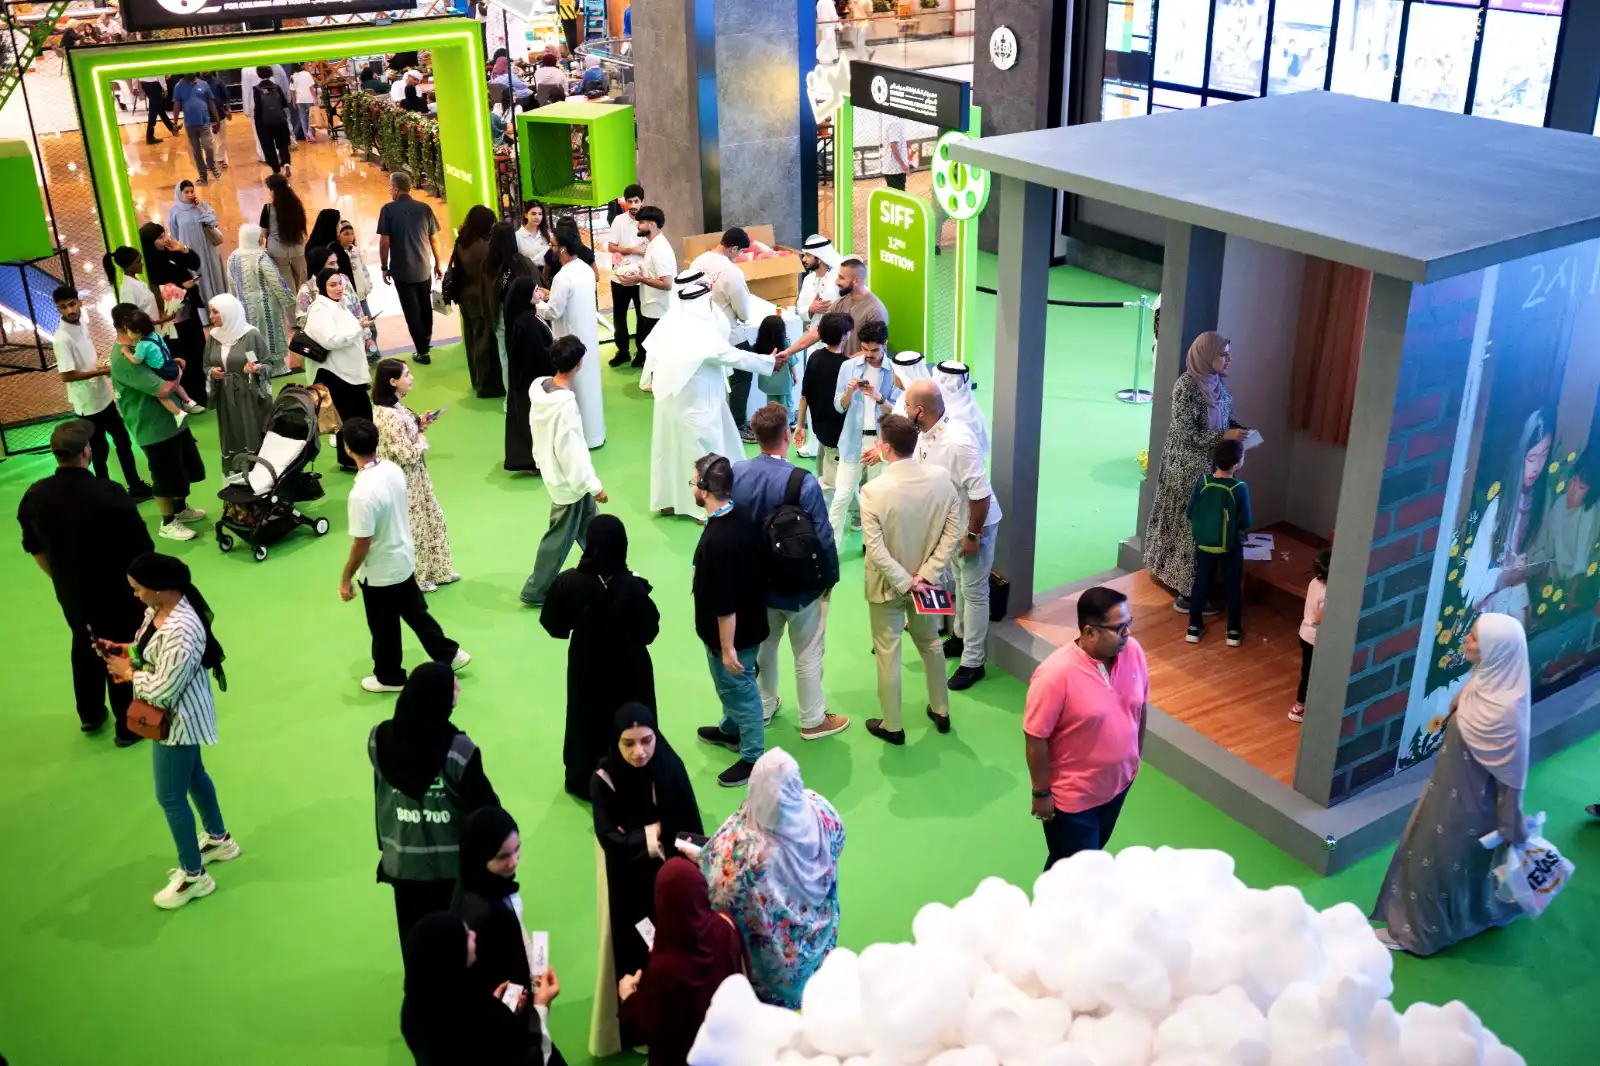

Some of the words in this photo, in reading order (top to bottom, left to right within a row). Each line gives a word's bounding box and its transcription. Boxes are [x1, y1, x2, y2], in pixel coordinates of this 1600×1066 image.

[880, 200, 915, 230] SIFF
[880, 249, 915, 272] EDITION
[423, 809, 450, 823] 700
